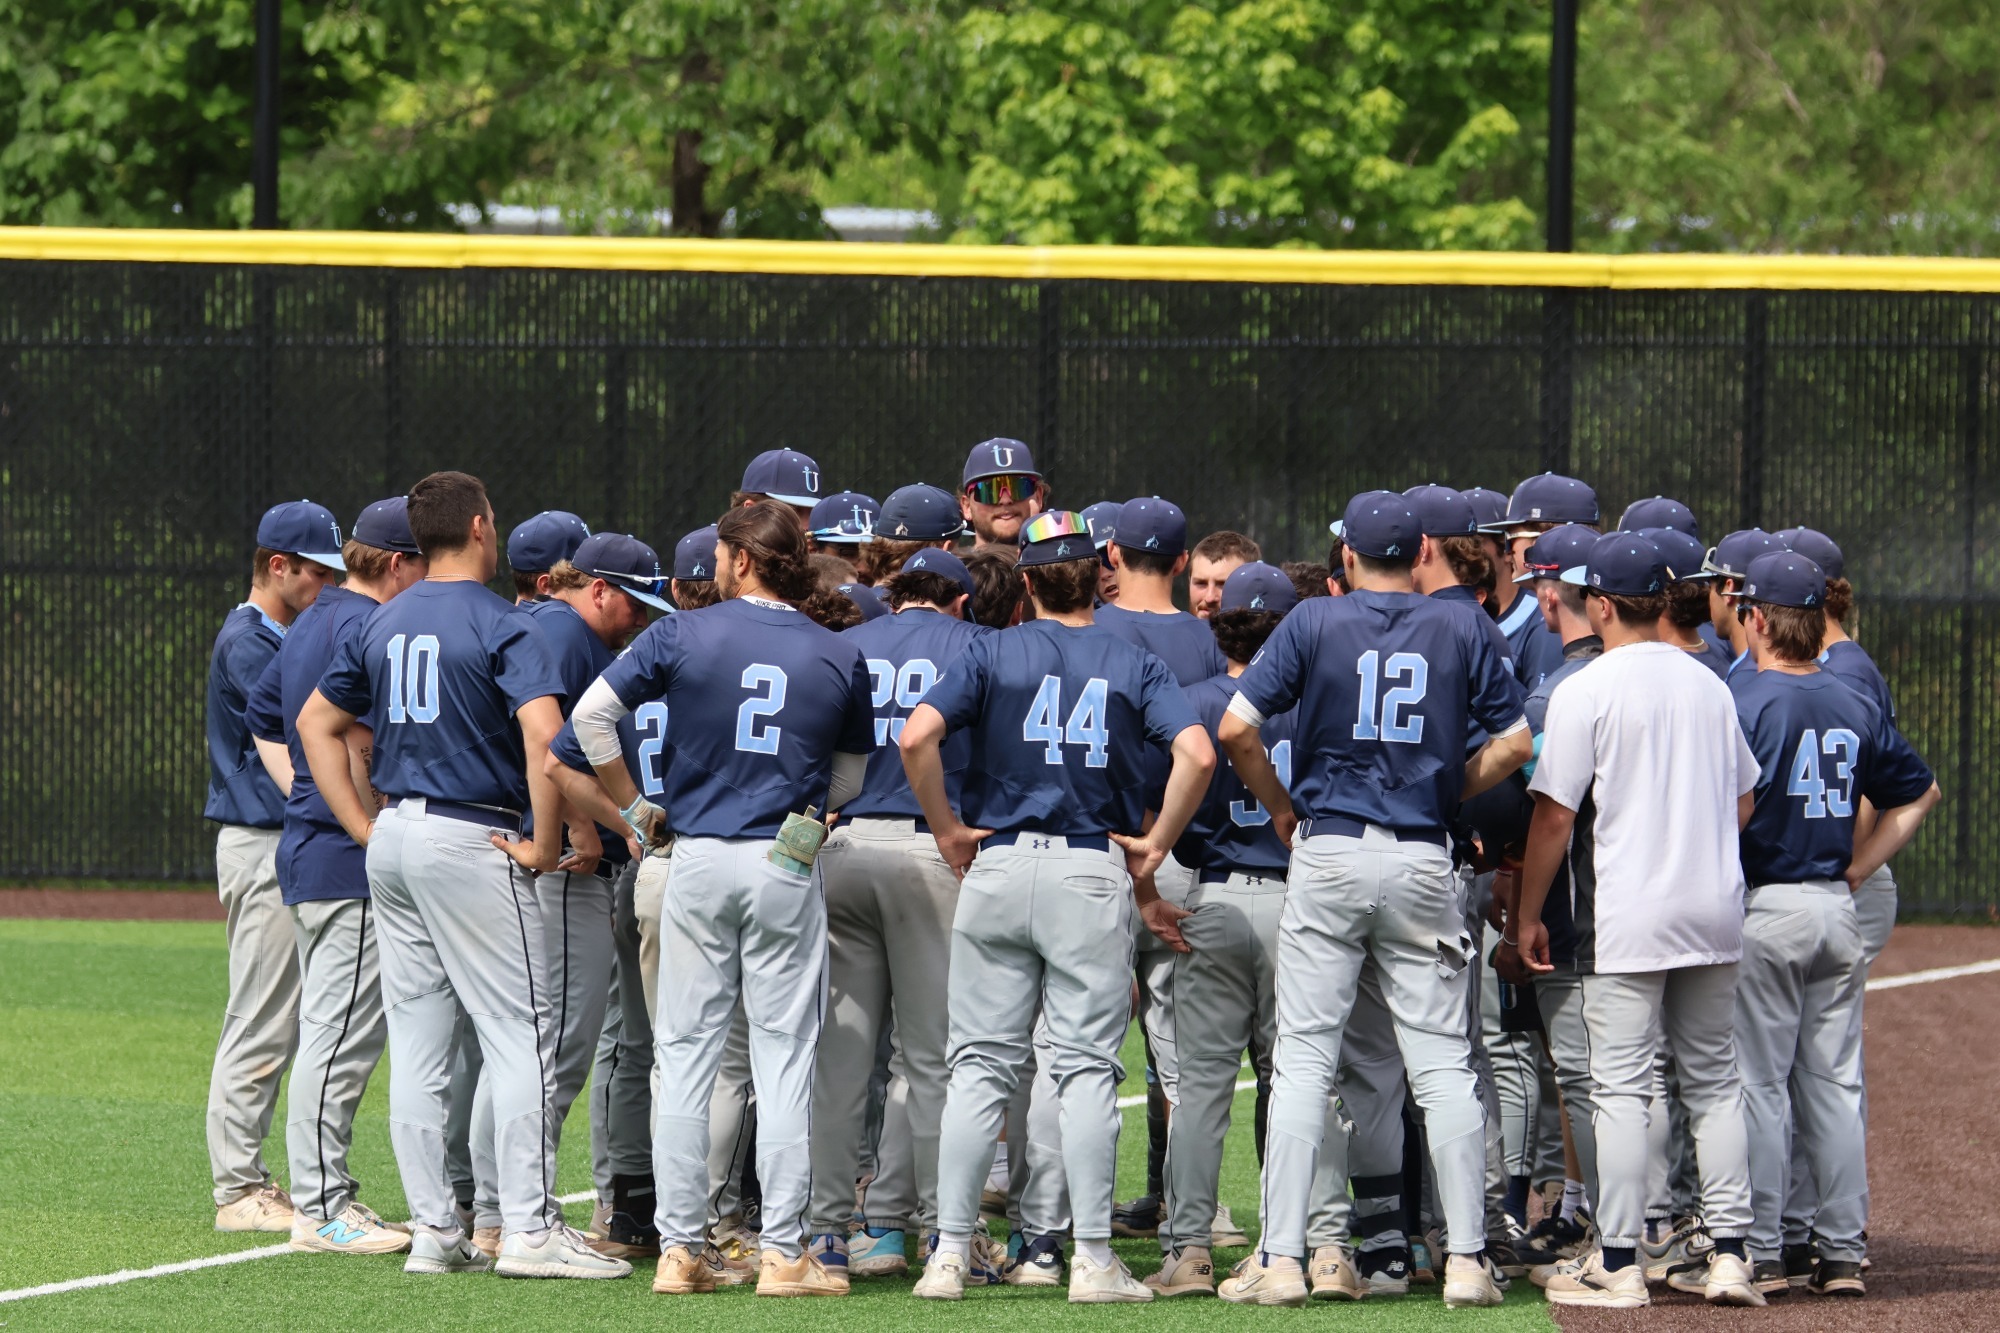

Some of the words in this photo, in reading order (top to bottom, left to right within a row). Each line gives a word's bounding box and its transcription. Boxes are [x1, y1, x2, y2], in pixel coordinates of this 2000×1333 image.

[802, 466, 819, 492] U
[990, 445, 1014, 468] U
[387, 633, 440, 724] 10
[734, 662, 788, 756] 2
[1023, 674, 1109, 769] 44
[1352, 649, 1429, 744] 12
[1786, 728, 1860, 819] 43
